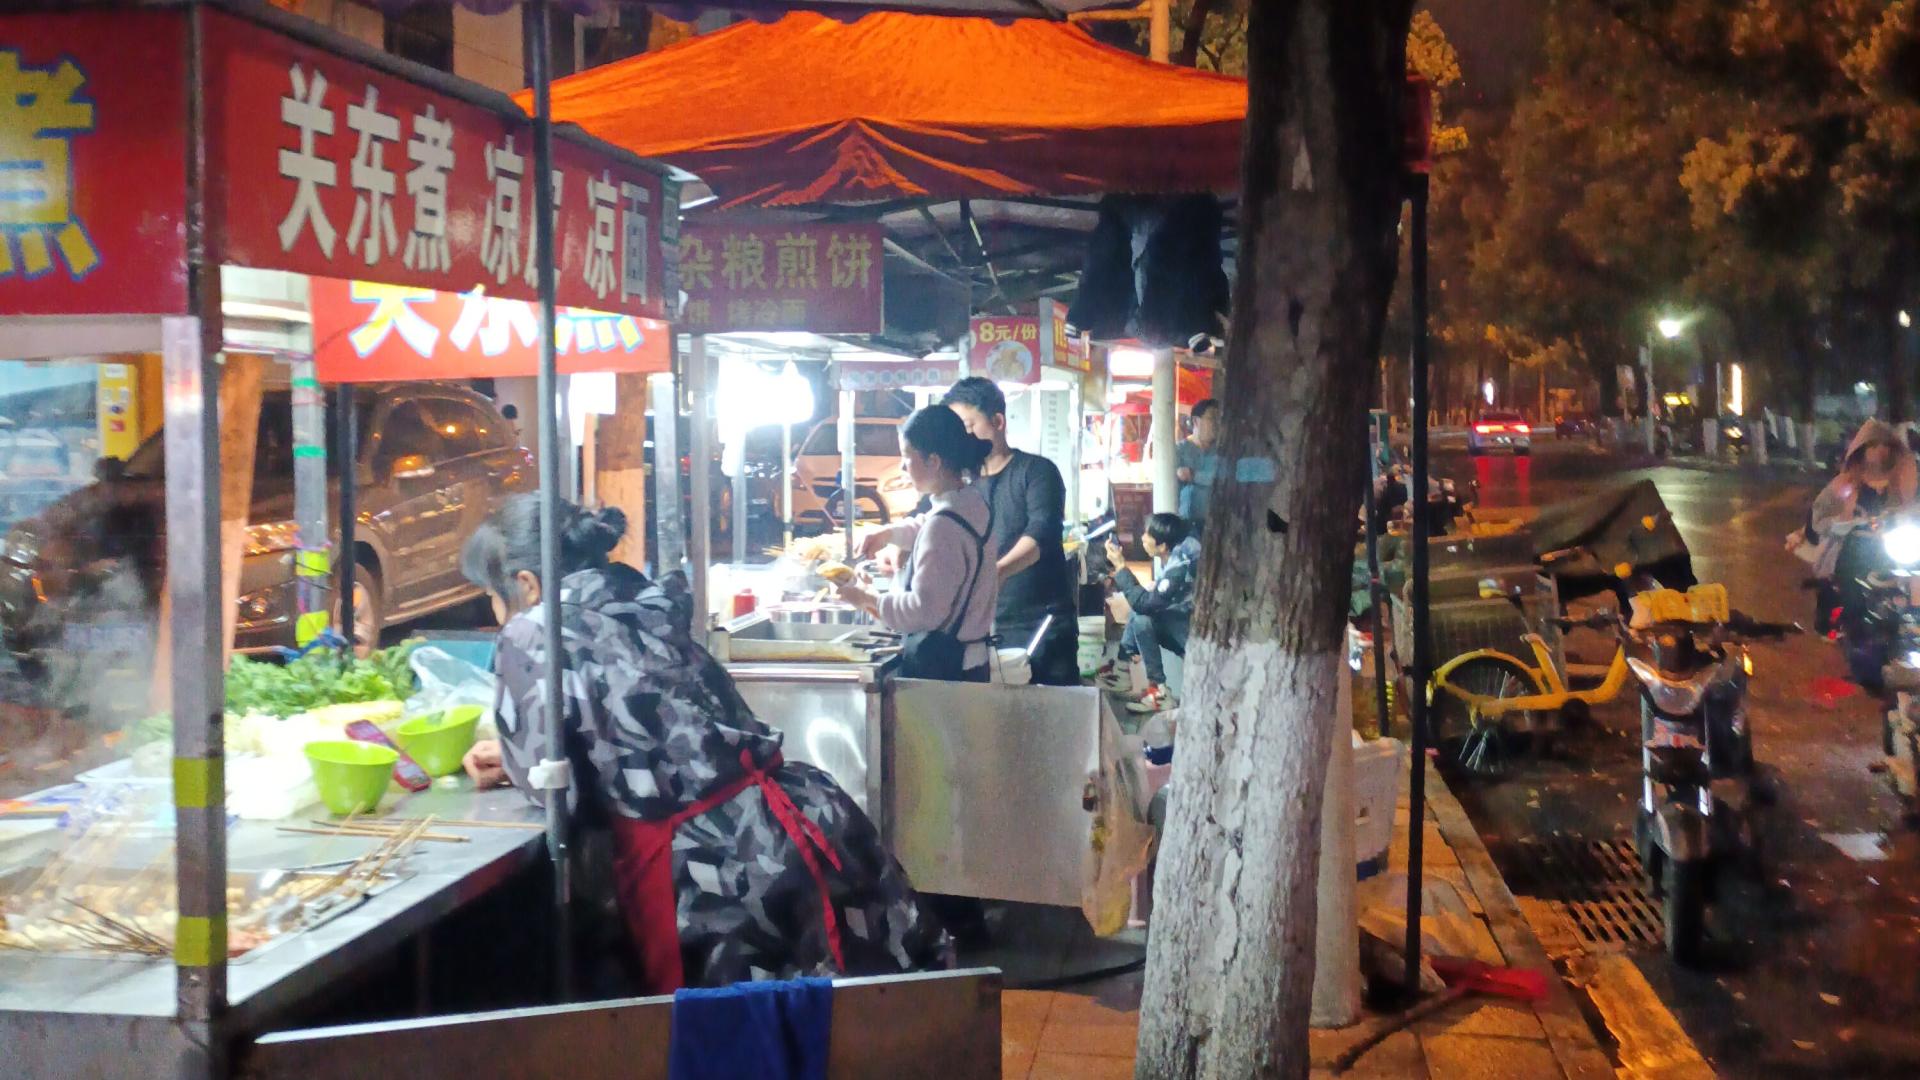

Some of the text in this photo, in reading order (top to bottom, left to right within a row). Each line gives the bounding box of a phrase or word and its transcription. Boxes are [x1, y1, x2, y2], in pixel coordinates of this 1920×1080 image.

[278, 63, 455, 274] 关东煮
[583, 168, 650, 305] 凉面
[678, 231, 873, 289] 杂粮煎饼
[979, 321, 1038, 342] 8元/份
